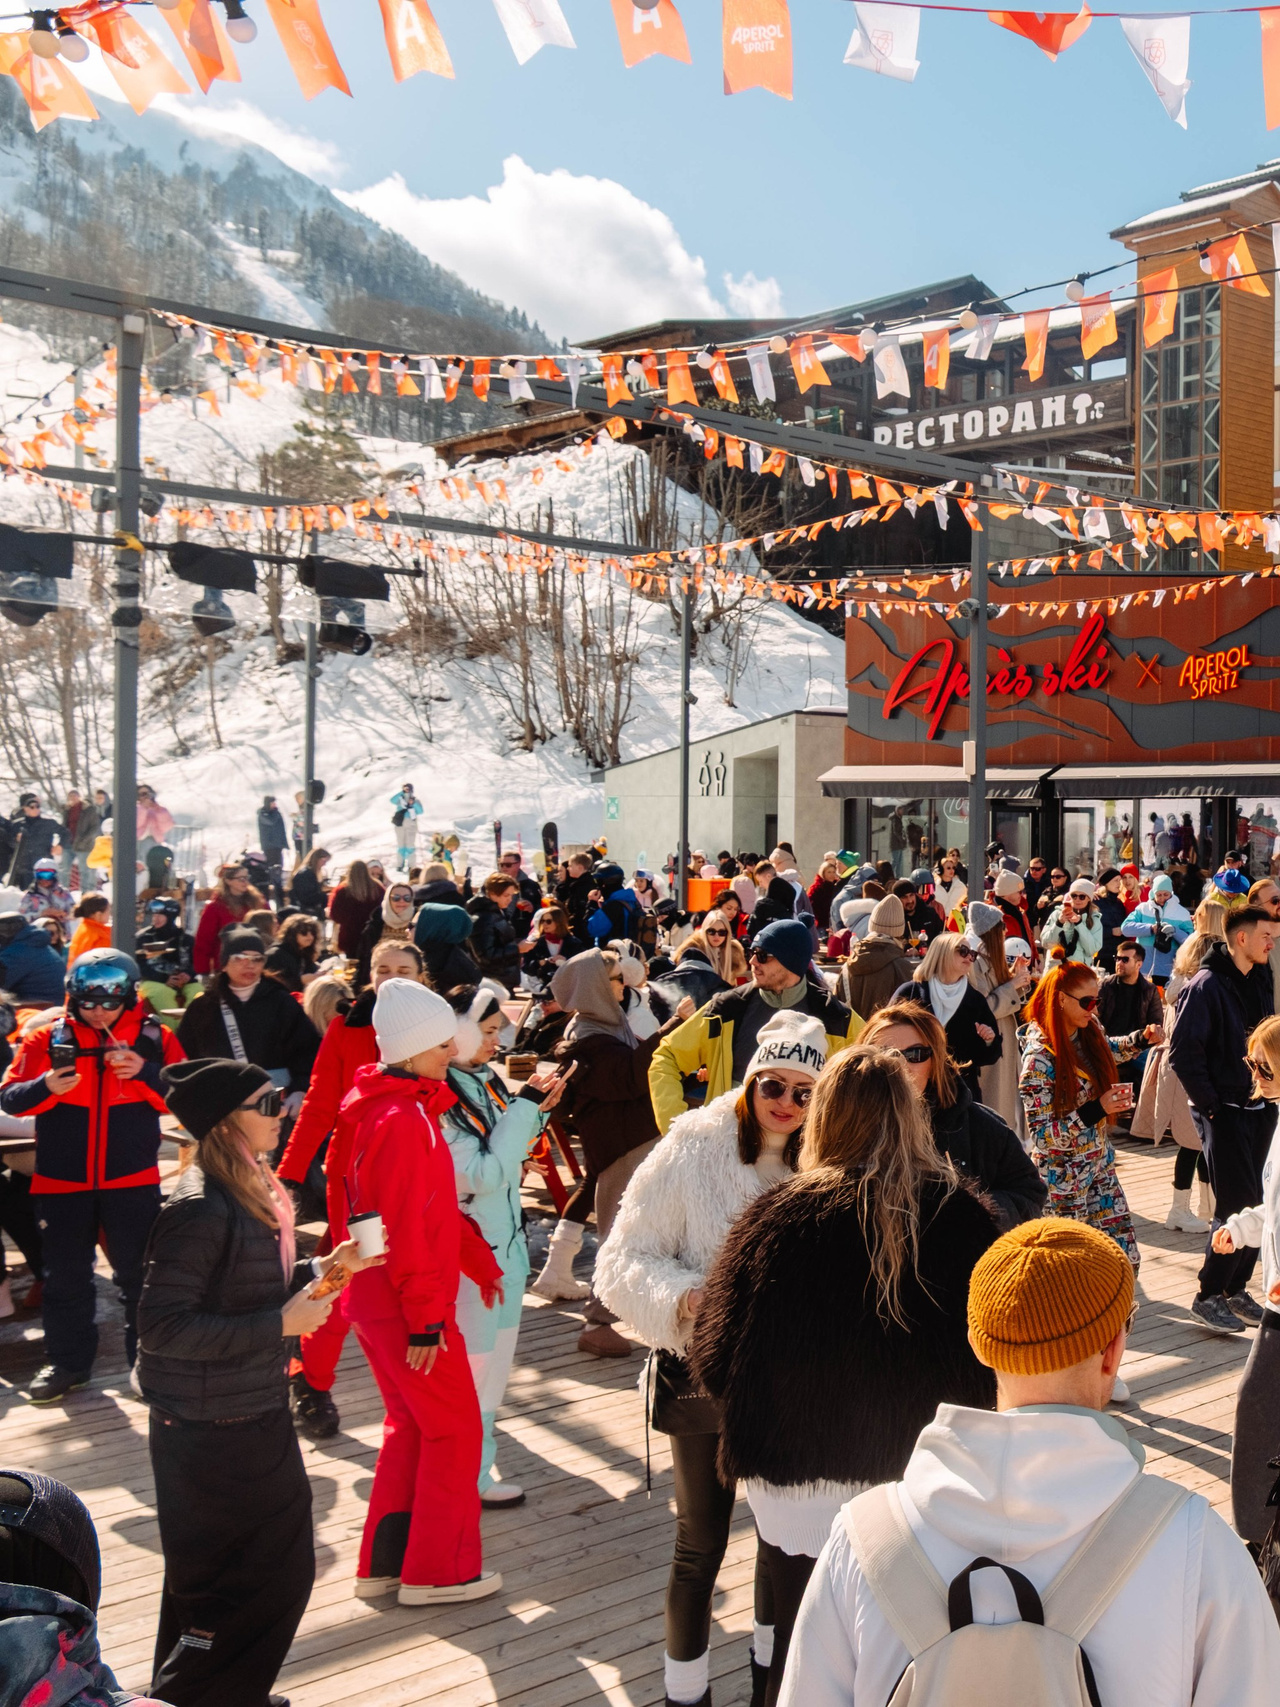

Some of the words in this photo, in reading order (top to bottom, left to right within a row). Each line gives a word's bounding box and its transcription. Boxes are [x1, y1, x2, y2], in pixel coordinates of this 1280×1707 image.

[398, 1, 426, 49] A
[731, 24, 784, 46] APEROL
[743, 40, 775, 54] SPRITZ
[33, 55, 63, 97] A
[801, 346, 813, 374] A
[924, 344, 938, 372] A
[873, 394, 1067, 450] РЕСТОРАН
[882, 639, 1033, 741] Apès
[1042, 613, 1111, 697] ski
[1178, 643, 1251, 687] APEROL
